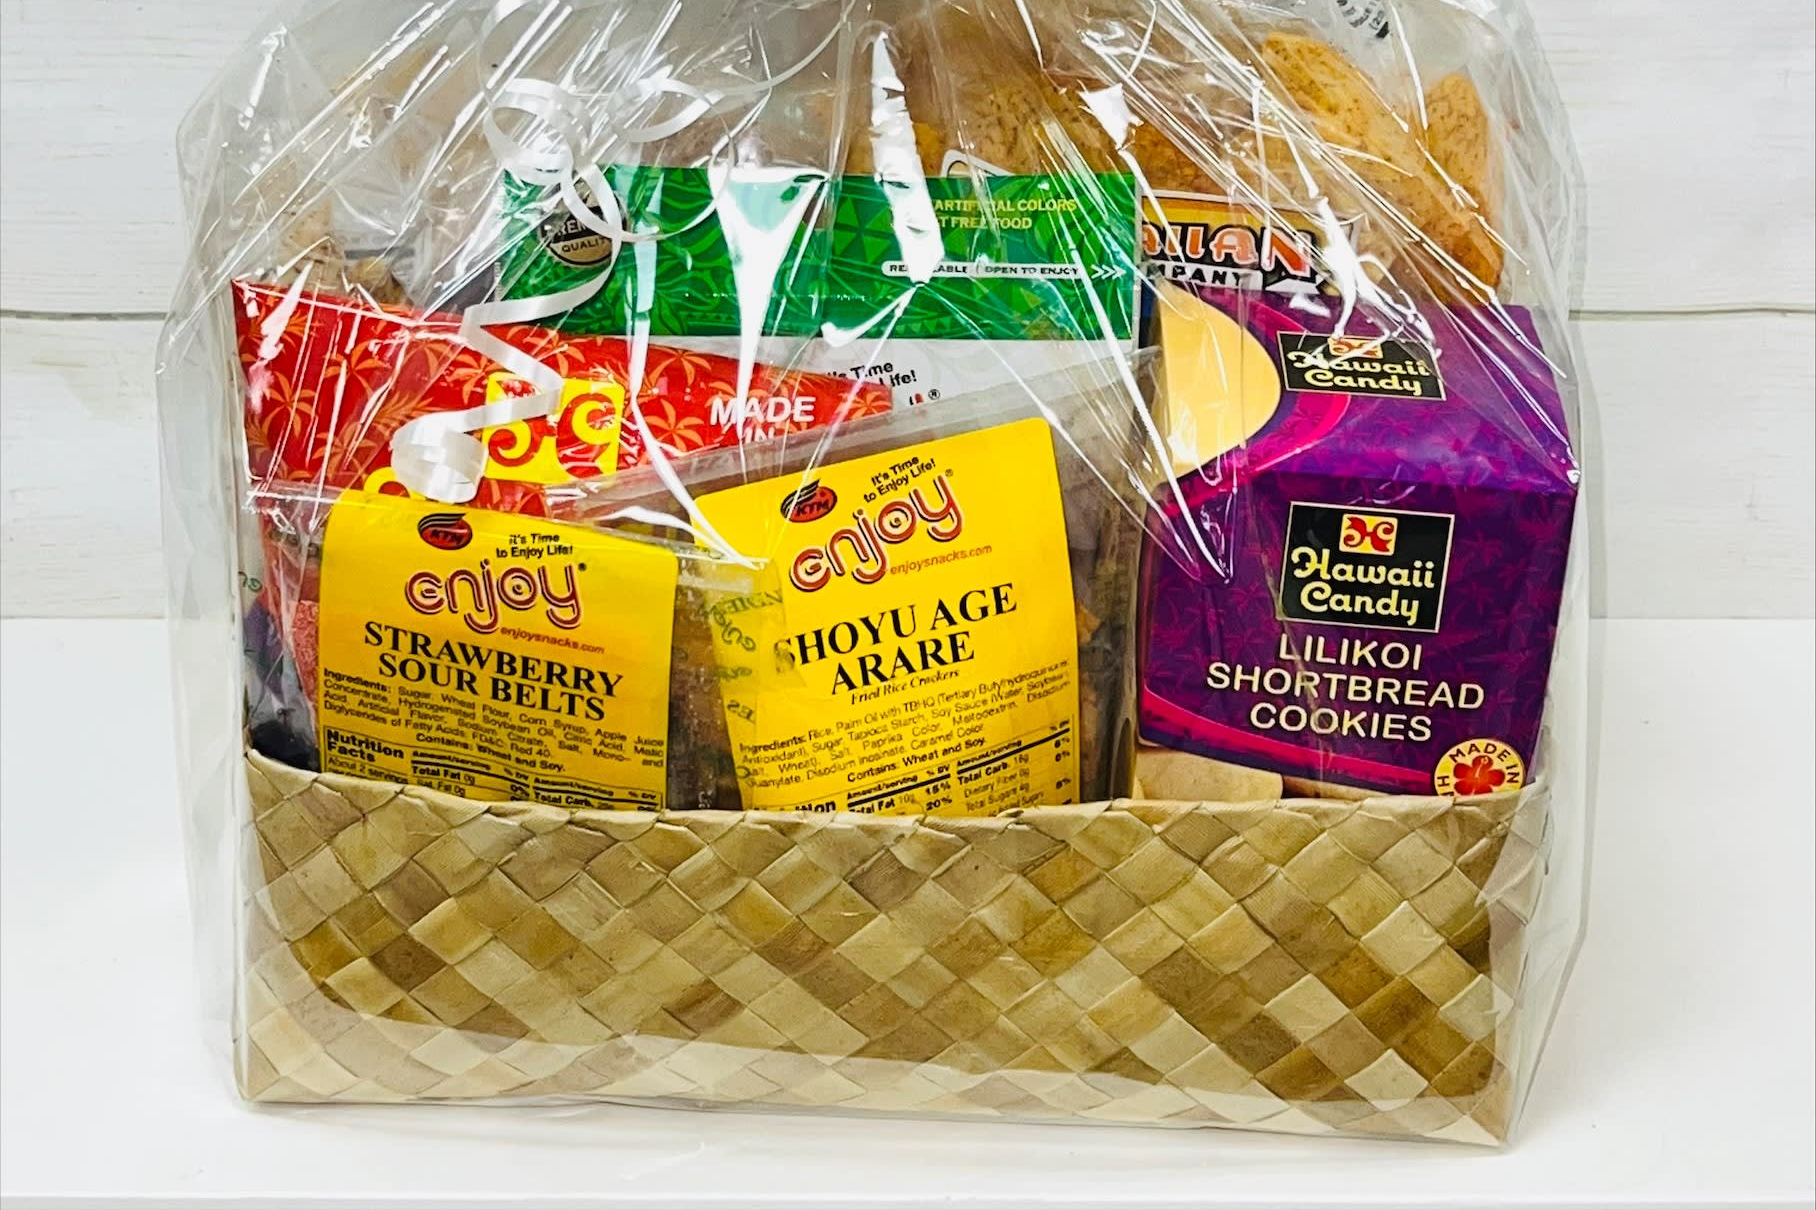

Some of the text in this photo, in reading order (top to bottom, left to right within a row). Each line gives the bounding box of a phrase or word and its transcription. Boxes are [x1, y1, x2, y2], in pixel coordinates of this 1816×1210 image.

[1017, 199, 1077, 212] COLORS
[561, 237, 606, 253] QUALI
[889, 265, 1079, 276] REABLE OPEN TO ENJOY
[1287, 350, 1431, 377] Hawaii
[1304, 369, 1422, 396] Candy
[710, 396, 817, 427] MADE
[863, 458, 936, 503] to Enjoy Life!
[871, 456, 920, 487] It's Time
[795, 499, 830, 517] KTM
[531, 533, 560, 544] Time
[789, 474, 964, 593] enjoy
[496, 545, 573, 559] to Enjoy Life!
[890, 544, 992, 576] enjoysnacks.com
[1291, 546, 1435, 590] Hawaii
[405, 558, 582, 634] enjoy
[1300, 586, 1420, 626] Candy
[500, 626, 605, 654] enjoysnacks.com
[774, 604, 917, 668] SHOYU
[930, 582, 1018, 630] AGE
[365, 621, 623, 697] STRAWBERRY
[831, 630, 975, 695] ARARE
[1279, 634, 1422, 671] LILIKOI
[378, 653, 605, 721] SOUR BELTS
[851, 670, 960, 706] Fried Rice Crackers
[1206, 662, 1484, 710] SHORTBREAD
[324, 668, 391, 693] Ingredients:
[441, 693, 475, 709] Wheat
[595, 728, 627, 741] Apple
[635, 735, 664, 747] Juice
[399, 698, 476, 720] Hydrogenated
[483, 715, 530, 734] Soybean
[848, 725, 888, 742] Tapioca
[931, 707, 951, 720] Soy
[955, 699, 988, 713] Sauce
[1250, 702, 1432, 742] COOKIES
[324, 700, 387, 725] Diglycerides
[391, 718, 401, 727] of
[405, 719, 433, 732] Fatty
[510, 743, 533, 756] Red
[327, 729, 405, 759] Nutrition
[457, 718, 498, 736] Sodium
[642, 759, 664, 768] and
[739, 734, 806, 753] Ingredients:
[836, 718, 862, 732] Palm
[864, 712, 878, 724] Oil
[880, 706, 901, 719] with
[862, 733, 903, 750] Paprika
[327, 741, 376, 763] Facts
[328, 757, 356, 771] About
[416, 733, 566, 773] Contains: Wheat and Soy.
[807, 759, 855, 781] Disodium
[911, 733, 953, 751] Caramel
[903, 750, 939, 767] Wheat
[942, 743, 962, 757] and
[1449, 743, 1520, 783] MADE IN
[412, 766, 441, 777] Total
[443, 770, 460, 781] Fat
[957, 772, 982, 787] Total
[534, 791, 562, 805] Total
[878, 798, 895, 812] Fat
[926, 797, 952, 812] 20%
